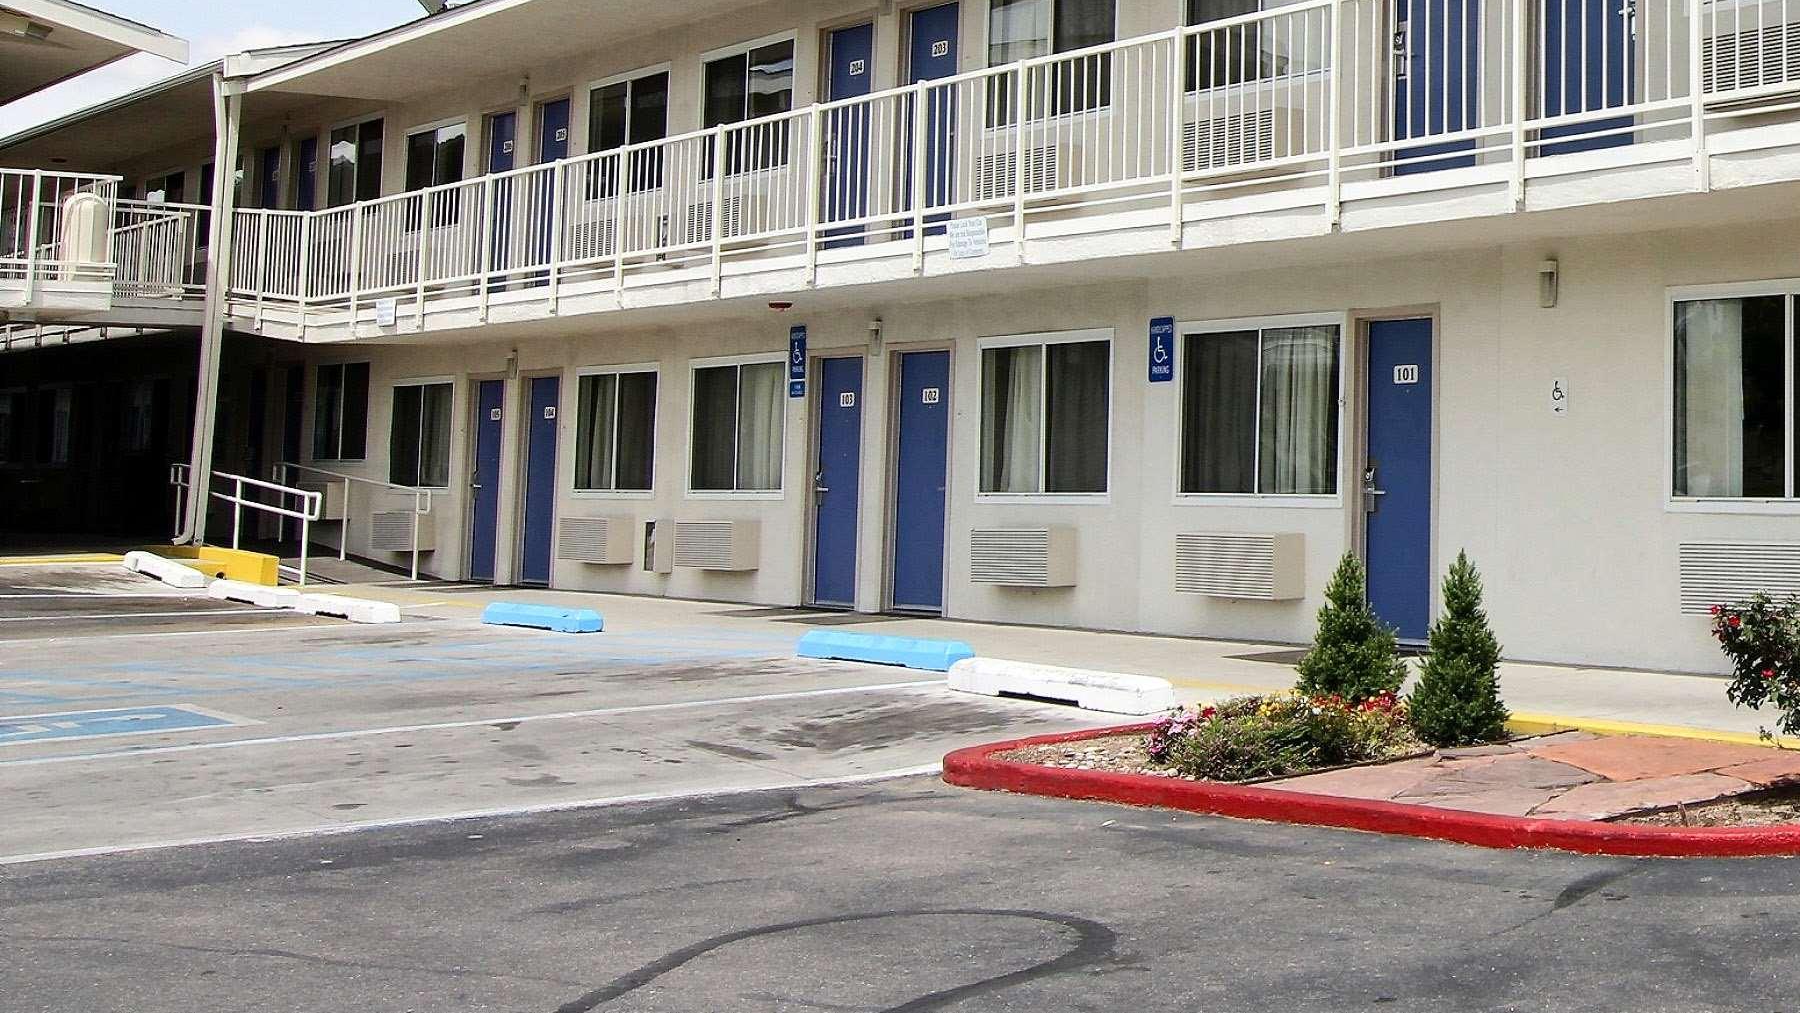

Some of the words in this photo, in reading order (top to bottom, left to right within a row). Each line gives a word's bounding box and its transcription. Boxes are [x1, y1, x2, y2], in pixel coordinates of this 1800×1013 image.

[933, 42, 947, 55] 203
[850, 61, 863, 73] 204
[1398, 367, 1414, 381] 101
[842, 393, 853, 405] 103
[924, 390, 937, 402] 102
